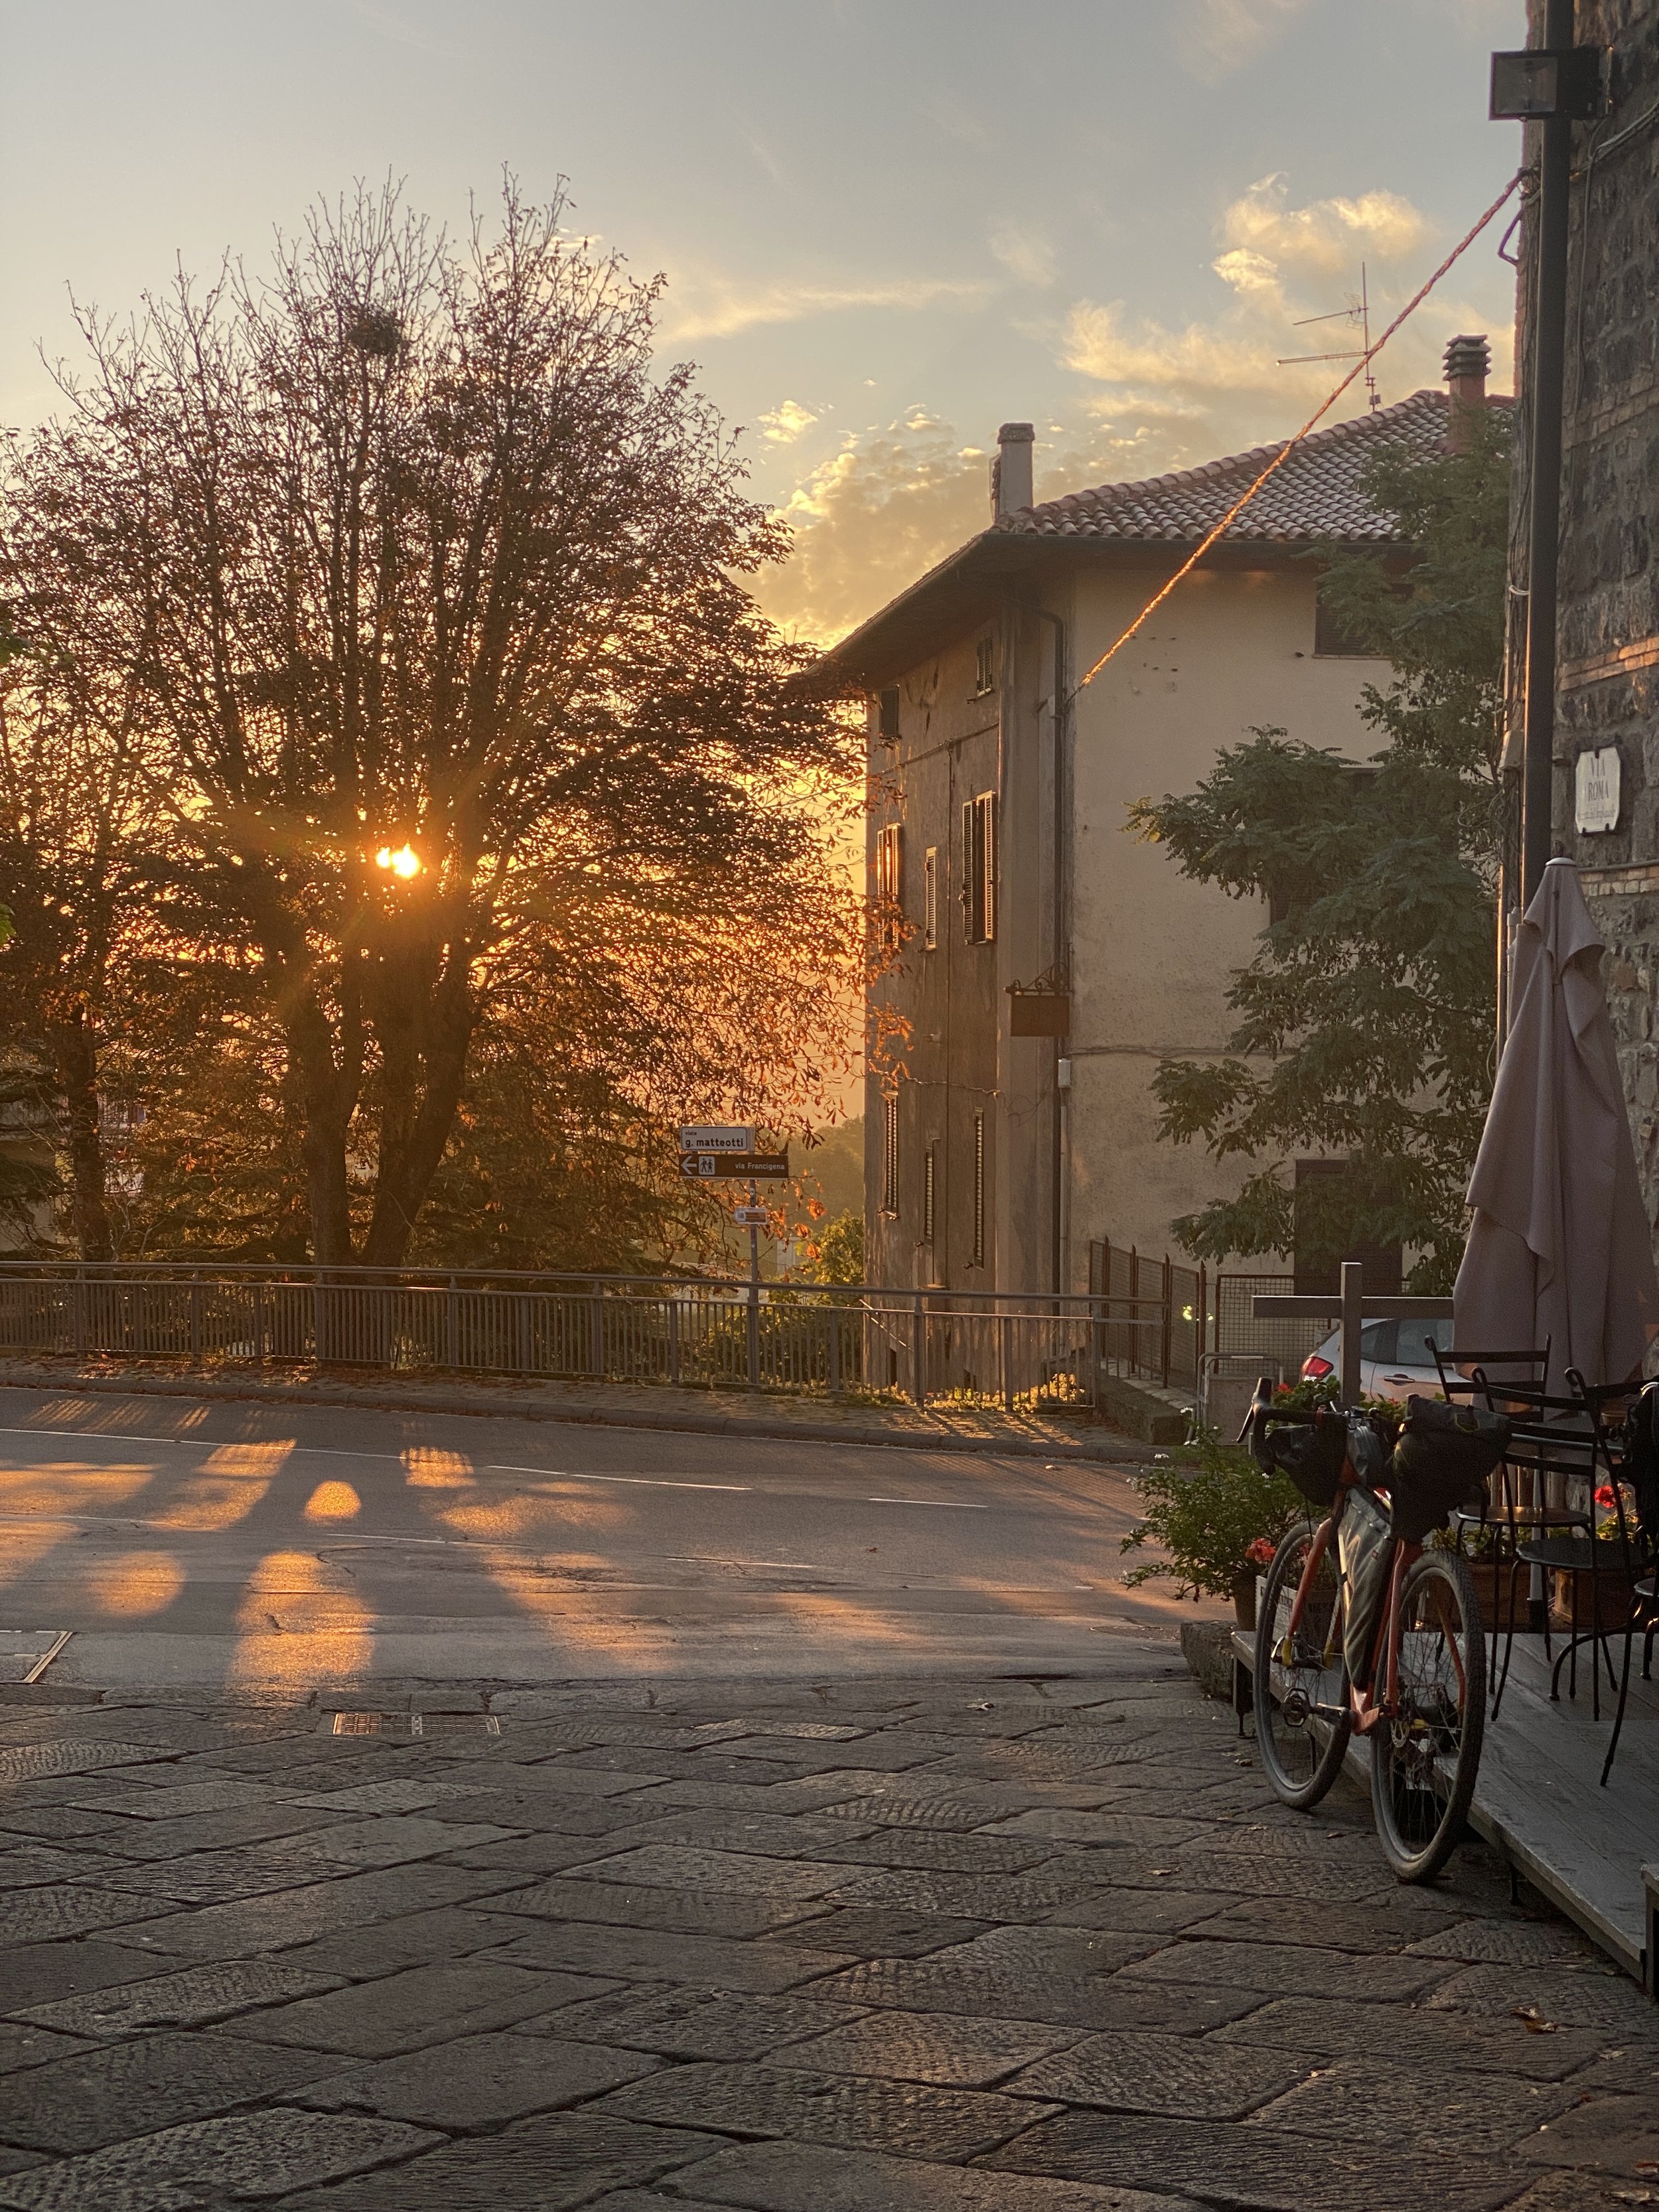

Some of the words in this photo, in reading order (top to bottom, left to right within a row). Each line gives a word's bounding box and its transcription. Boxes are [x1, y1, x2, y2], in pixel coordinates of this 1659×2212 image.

[1591, 757, 1605, 776] VIA
[1587, 780, 1609, 802] ROMA
[696, 1138, 743, 1147] matteotti
